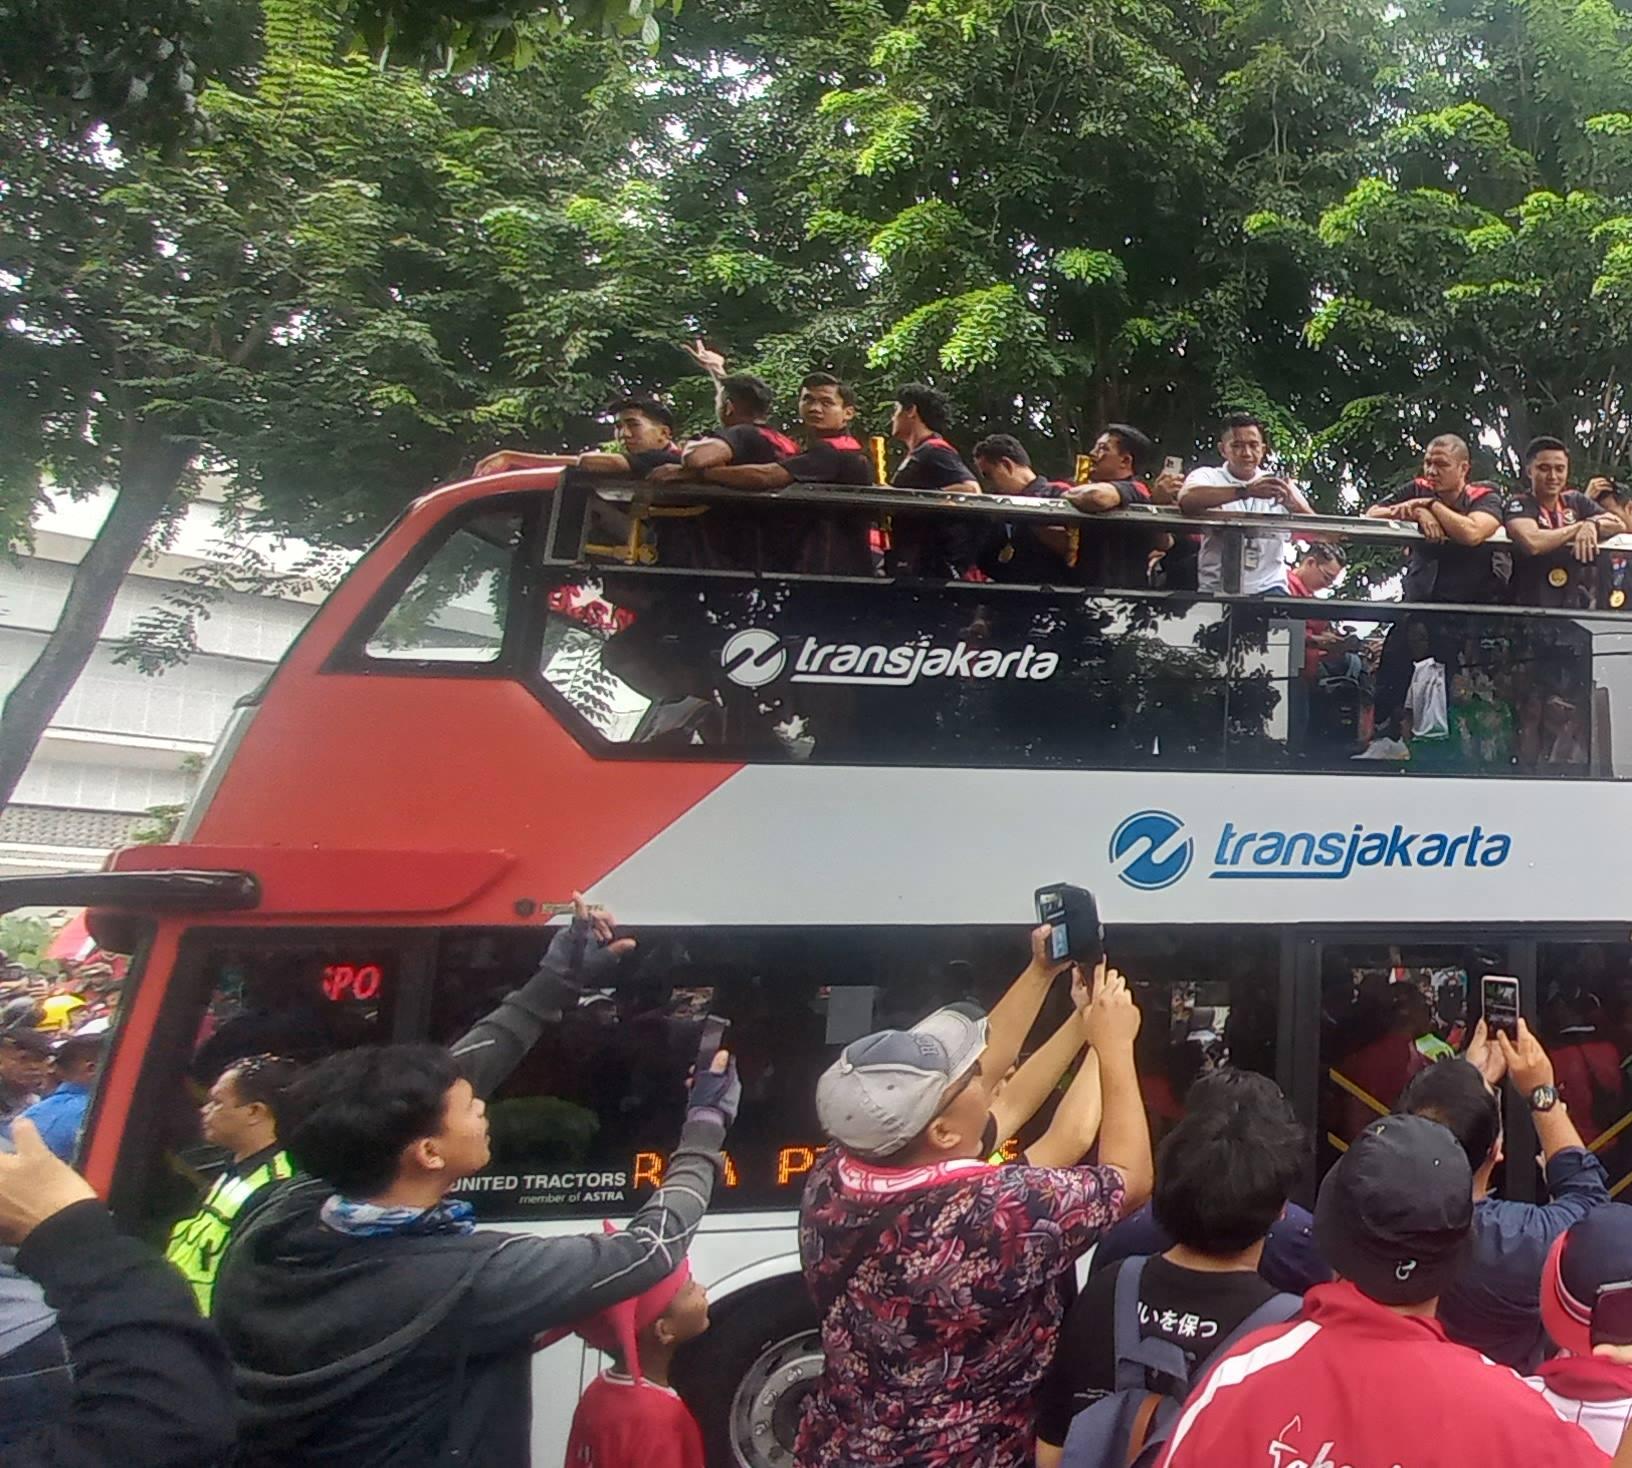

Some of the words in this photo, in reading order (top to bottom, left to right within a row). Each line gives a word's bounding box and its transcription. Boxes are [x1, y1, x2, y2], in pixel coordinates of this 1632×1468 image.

[793, 635, 1061, 686] transjakarta
[1211, 822, 1512, 880] transjakarta
[518, 1193, 567, 1205] member
[570, 1192, 582, 1203] of
[582, 1191, 625, 1202] ASTRA
[522, 1171, 627, 1190] TRACTORS
[1136, 1301, 1219, 1338] いを保つ
